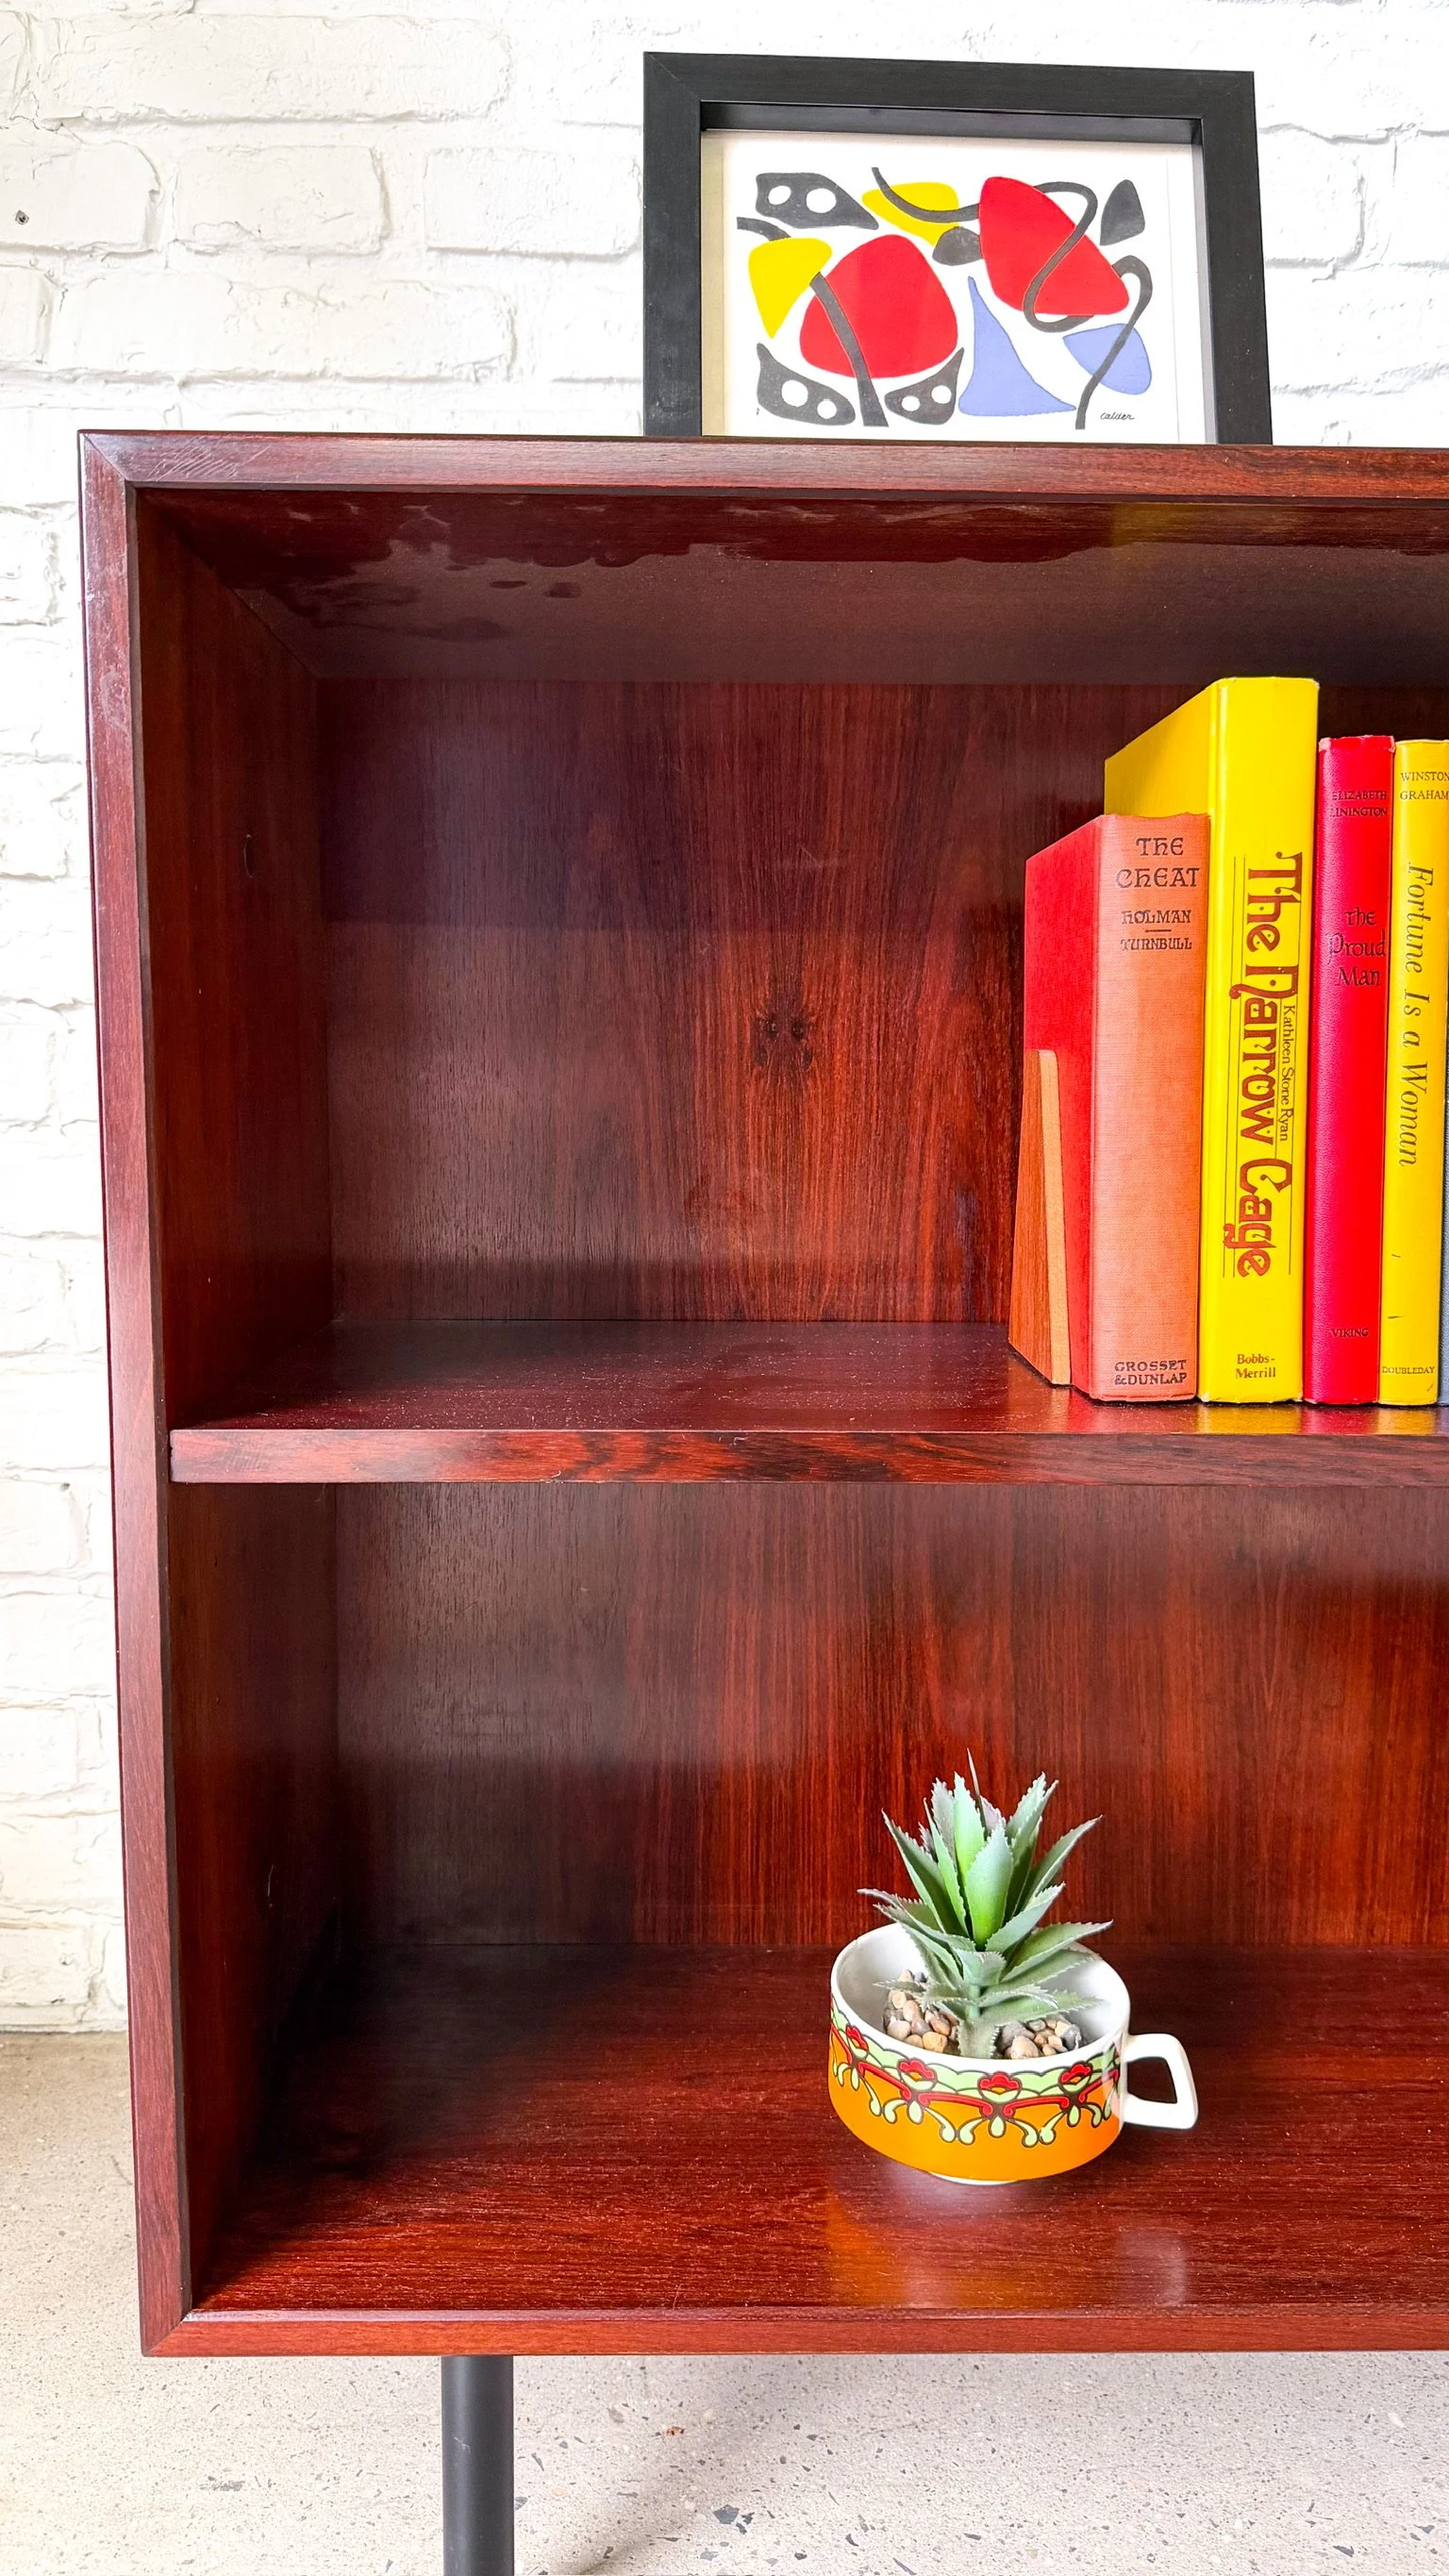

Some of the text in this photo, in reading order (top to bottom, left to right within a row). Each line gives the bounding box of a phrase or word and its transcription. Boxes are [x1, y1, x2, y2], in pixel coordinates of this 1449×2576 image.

[1332, 790, 1387, 800] ELIZABETH
[1399, 790, 1449, 800] GRAHAM
[1332, 806, 1388, 818] ININGTON
[1136, 837, 1184, 856] THE
[1115, 867, 1200, 889] CHEAT
[1121, 909, 1191, 925] HOLMAN
[1120, 937, 1192, 951] TURNBULL
[1325, 928, 1386, 964] Proud
[1335, 966, 1380, 987] Man
[1398, 861, 1434, 1167] Fortune Is a Woman
[1223, 851, 1303, 1278] The Narrow Cage
[1277, 1005, 1296, 1142] Kathleen Stone Ryan
[1331, 1328, 1370, 1338] VIKING
[1237, 1353, 1275, 1364] Bobbs-
[1114, 1360, 1187, 1372] GROSSET
[1235, 1367, 1276, 1379] Merrill
[1382, 1366, 1436, 1375] DOUBLEDAY
